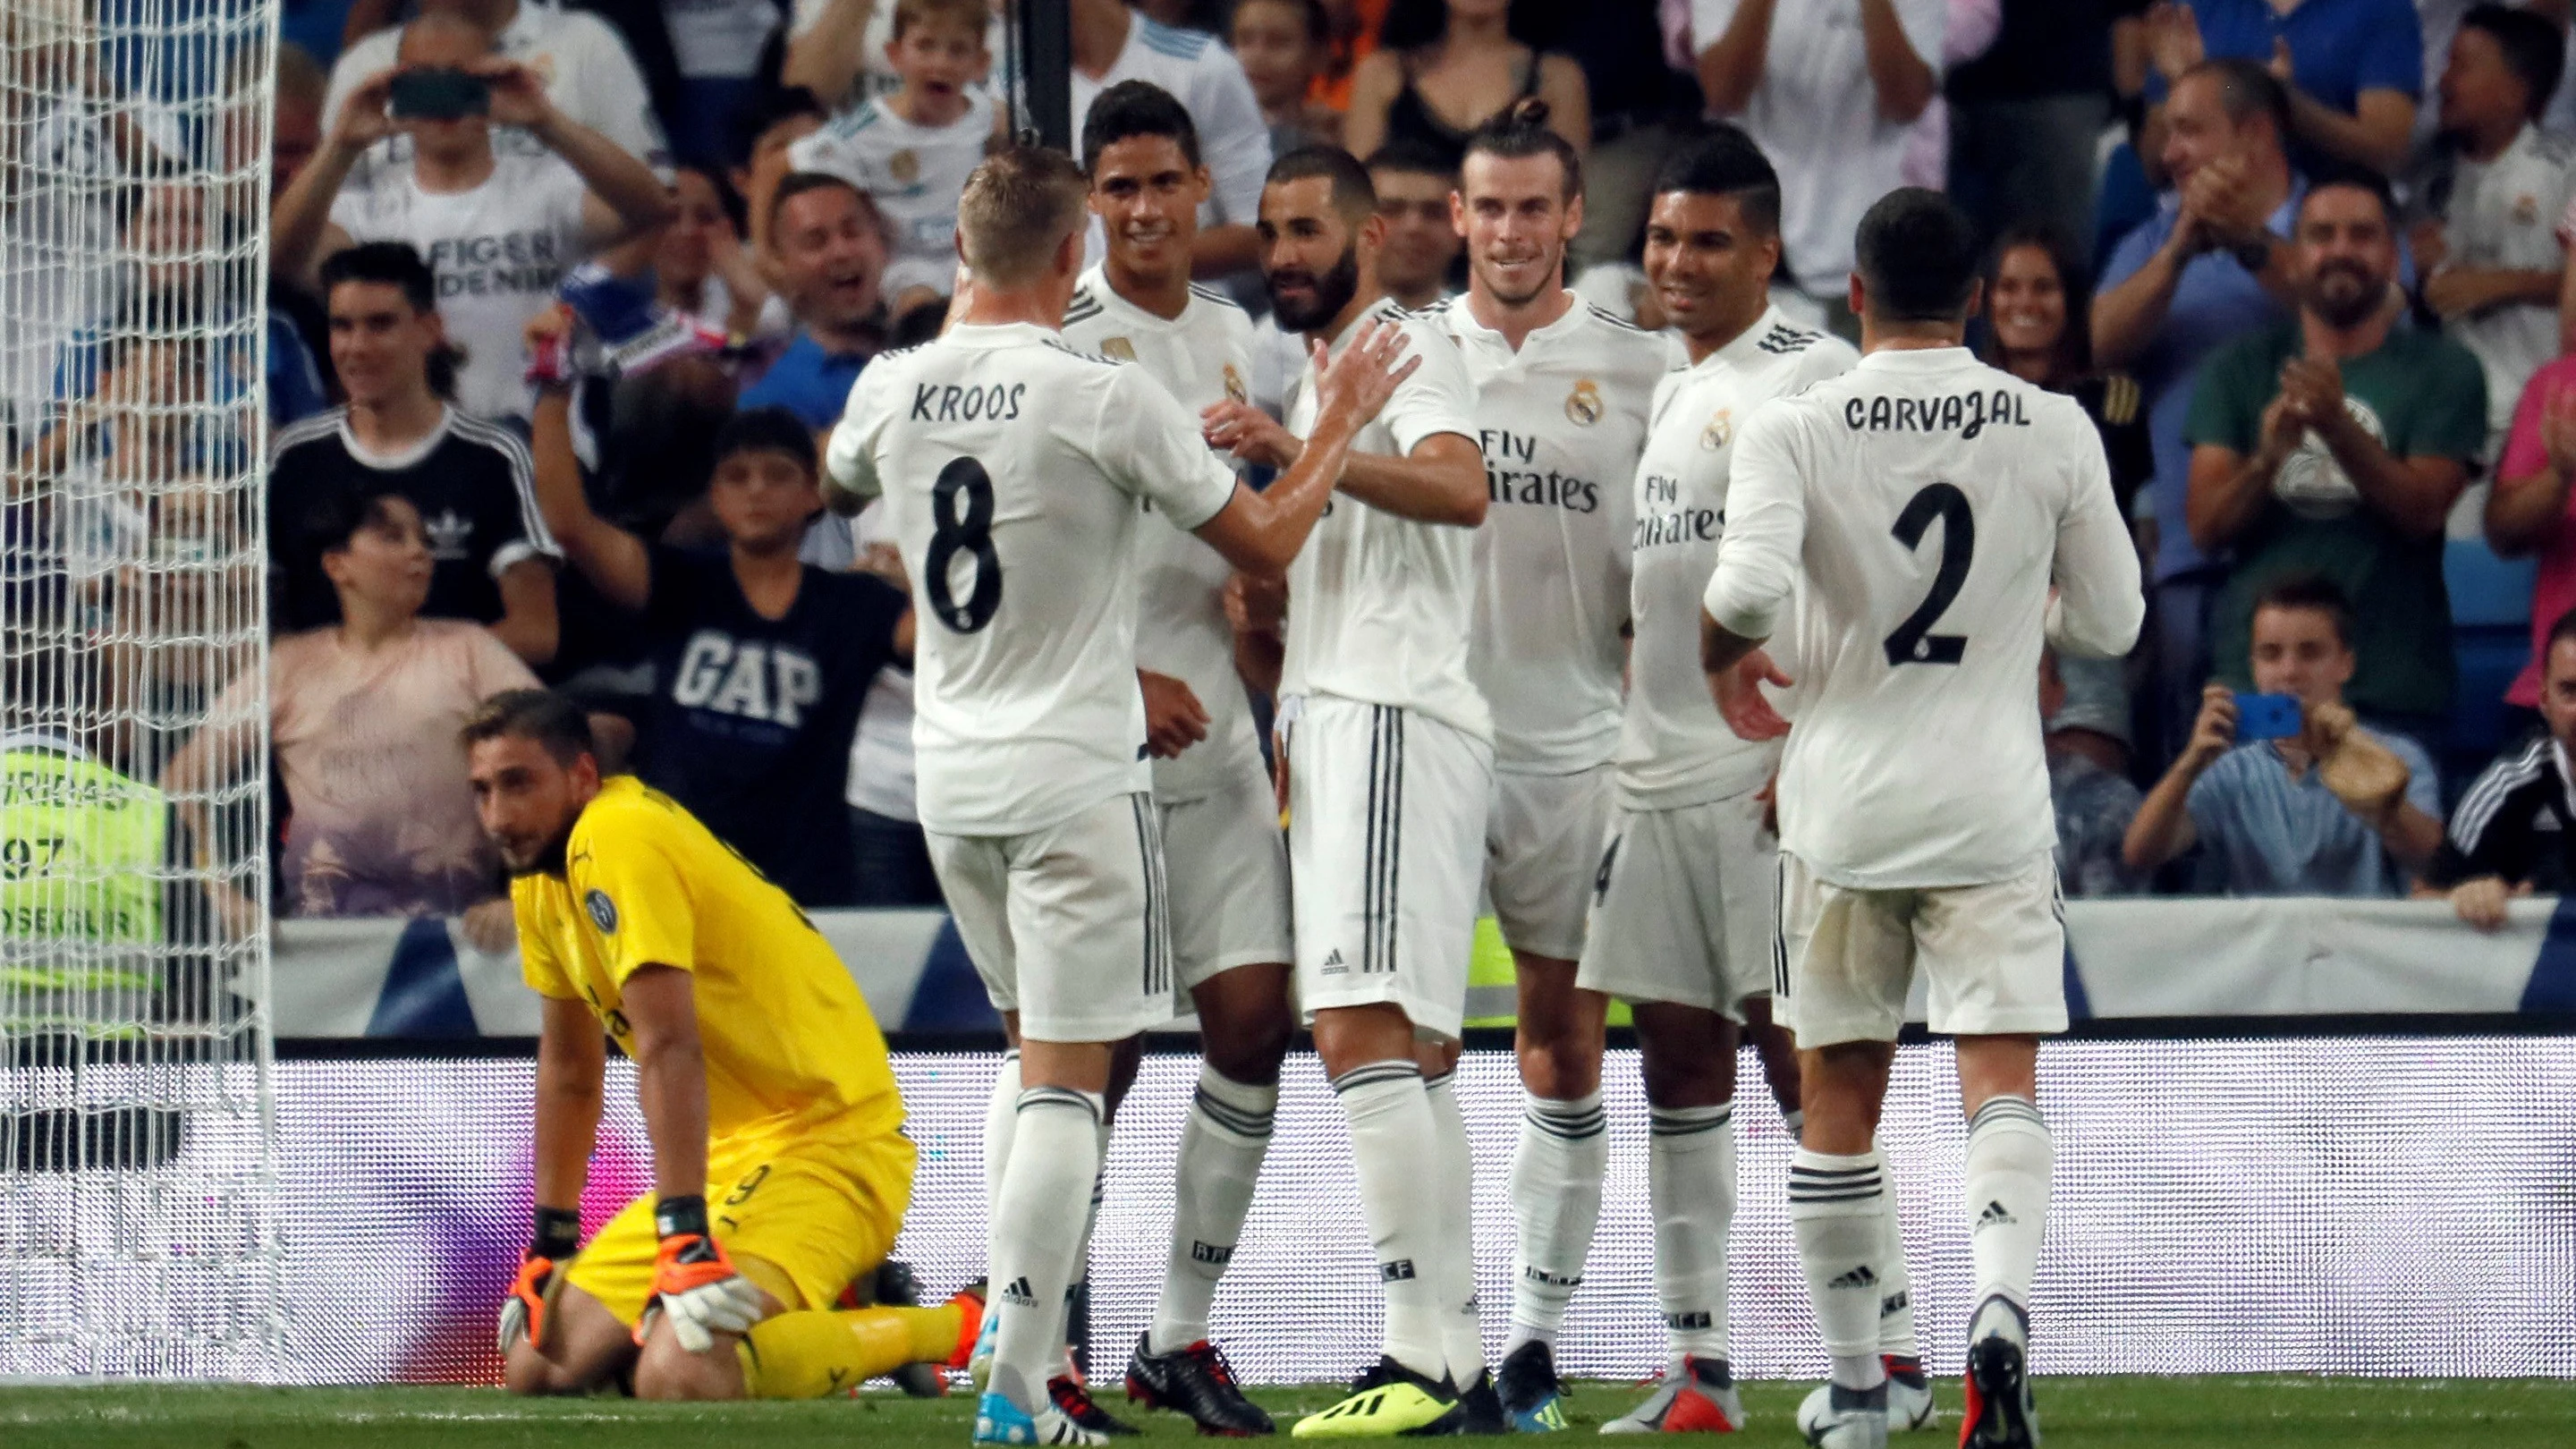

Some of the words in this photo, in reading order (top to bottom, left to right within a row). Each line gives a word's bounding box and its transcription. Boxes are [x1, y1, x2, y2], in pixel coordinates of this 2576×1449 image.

[910, 382, 1026, 421] KROOS
[1845, 389, 2031, 439] CARVAJAL
[1479, 429, 1537, 464] Fly
[1645, 475, 1678, 504] Fly
[926, 455, 1003, 634] 8
[1883, 482, 1975, 665] 2
[673, 631, 821, 729] GAP
[4, 837, 65, 881] 97
